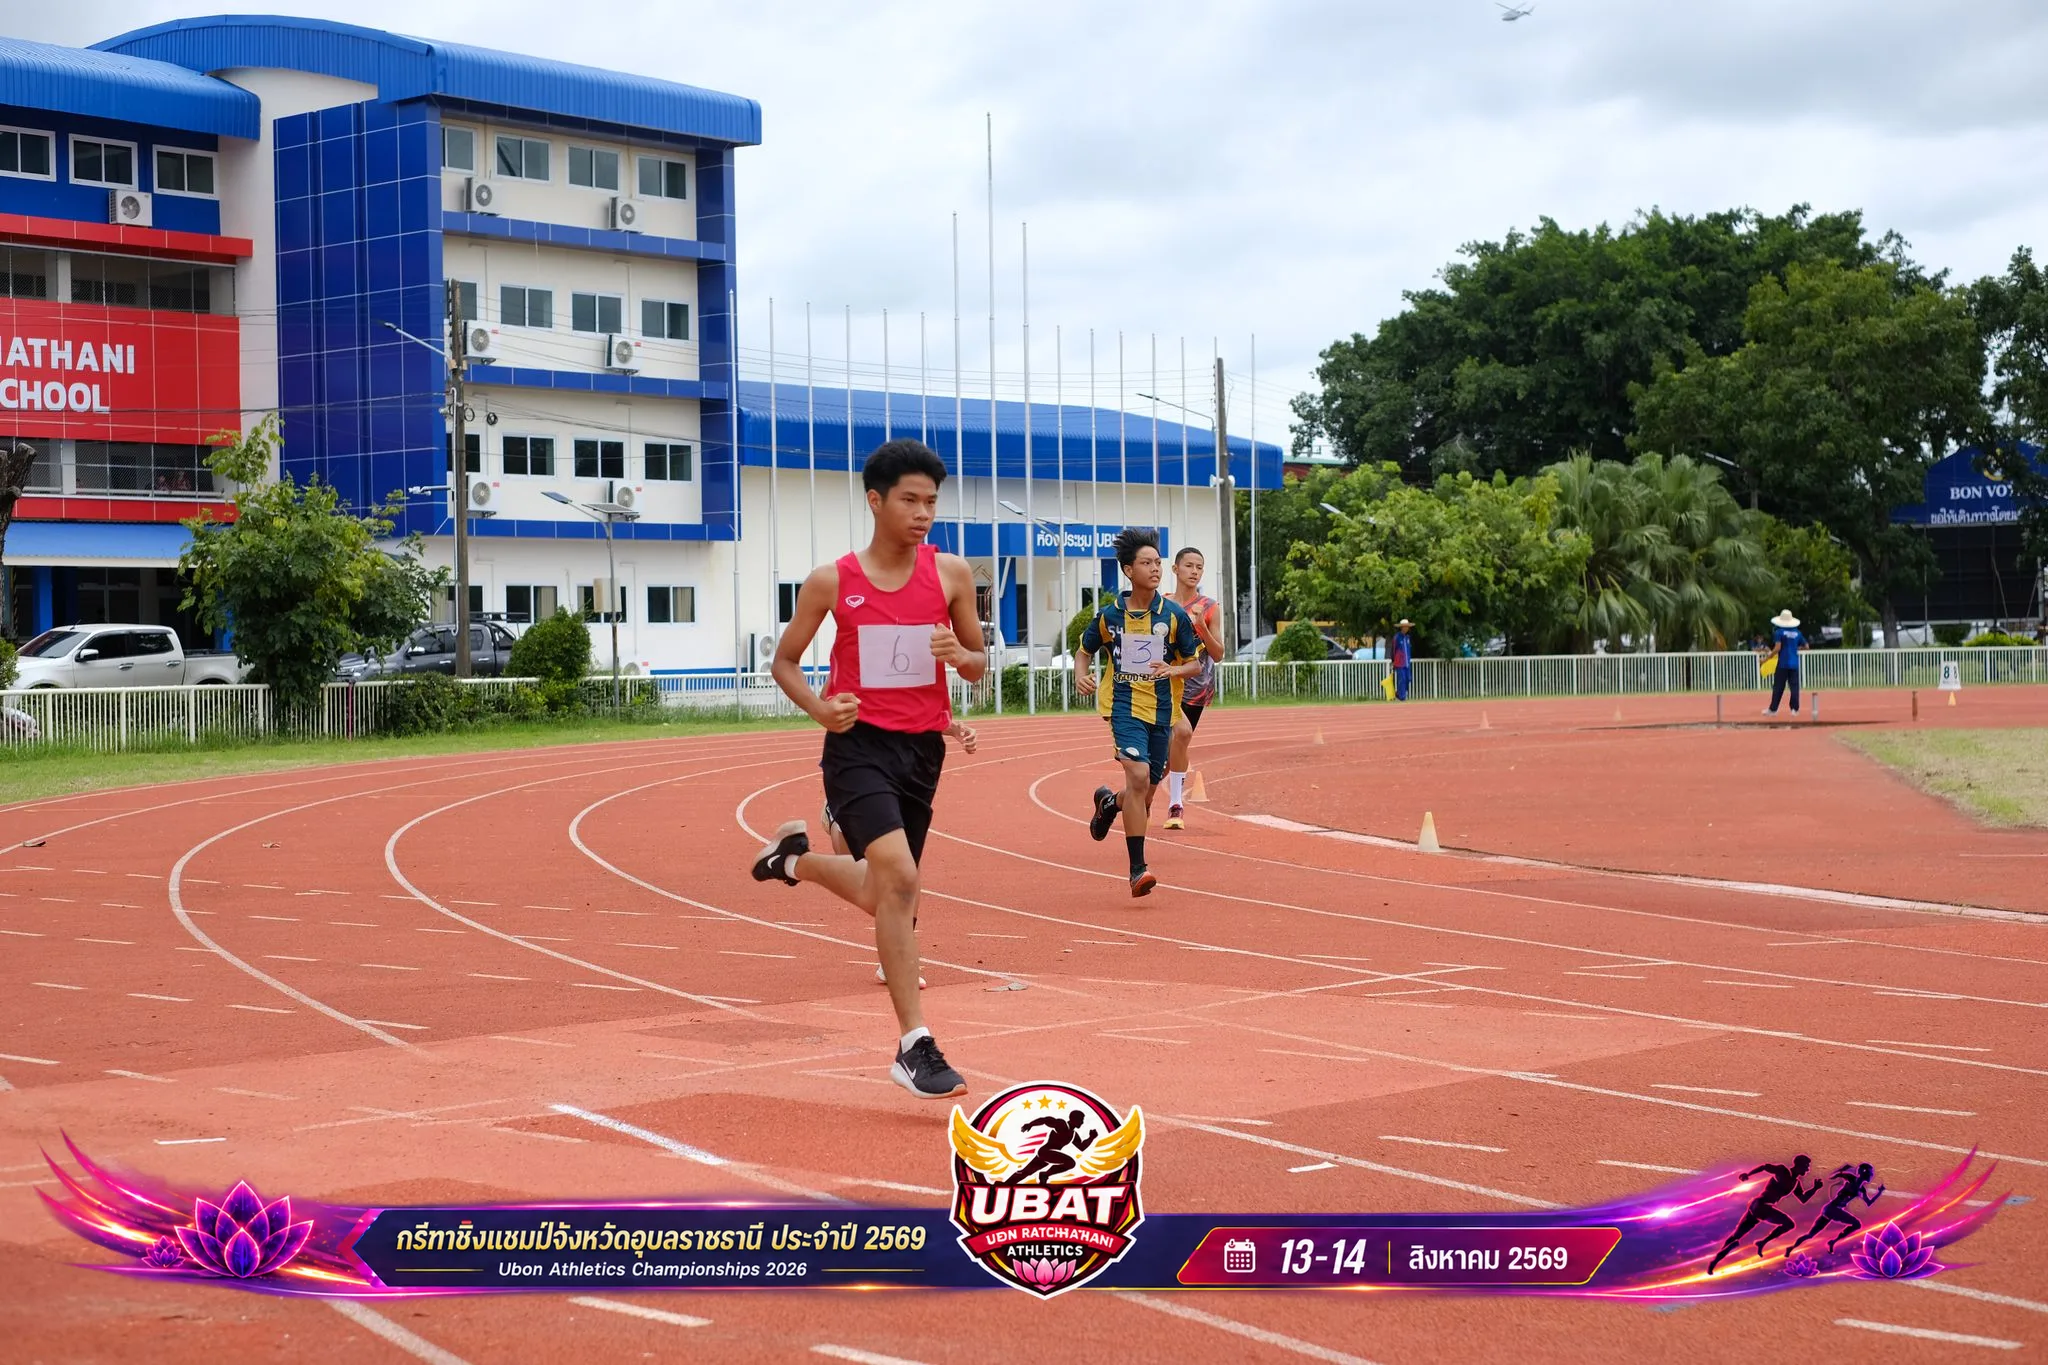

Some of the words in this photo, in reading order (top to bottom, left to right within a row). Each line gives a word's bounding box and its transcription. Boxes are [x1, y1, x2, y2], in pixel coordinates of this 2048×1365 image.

[0, 335, 135, 374] ATHANI
[1950, 486, 1982, 500] BON
[891, 634, 911, 673] 6
[1131, 639, 1152, 664] 3
[1943, 665, 1950, 680] 8
